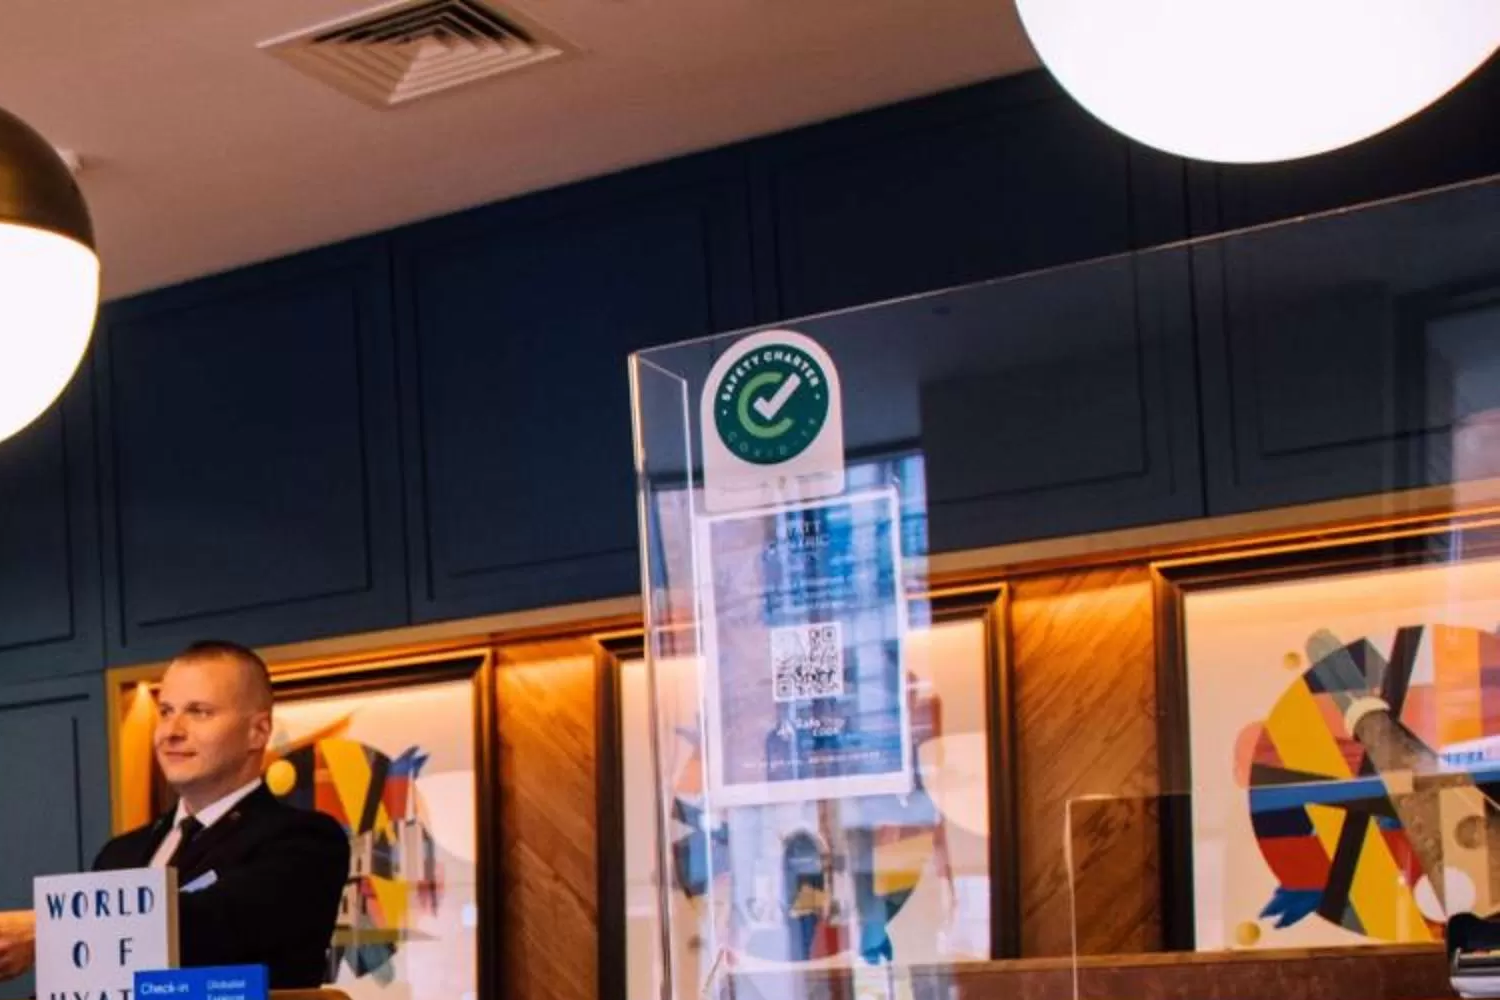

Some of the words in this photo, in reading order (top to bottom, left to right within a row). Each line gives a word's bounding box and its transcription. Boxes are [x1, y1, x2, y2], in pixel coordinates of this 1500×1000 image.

[721, 354, 760, 401] SAFETY
[763, 351, 820, 387] CHARTER
[46, 886, 155, 919] WORLD
[140, 981, 189, 995] Check-in
